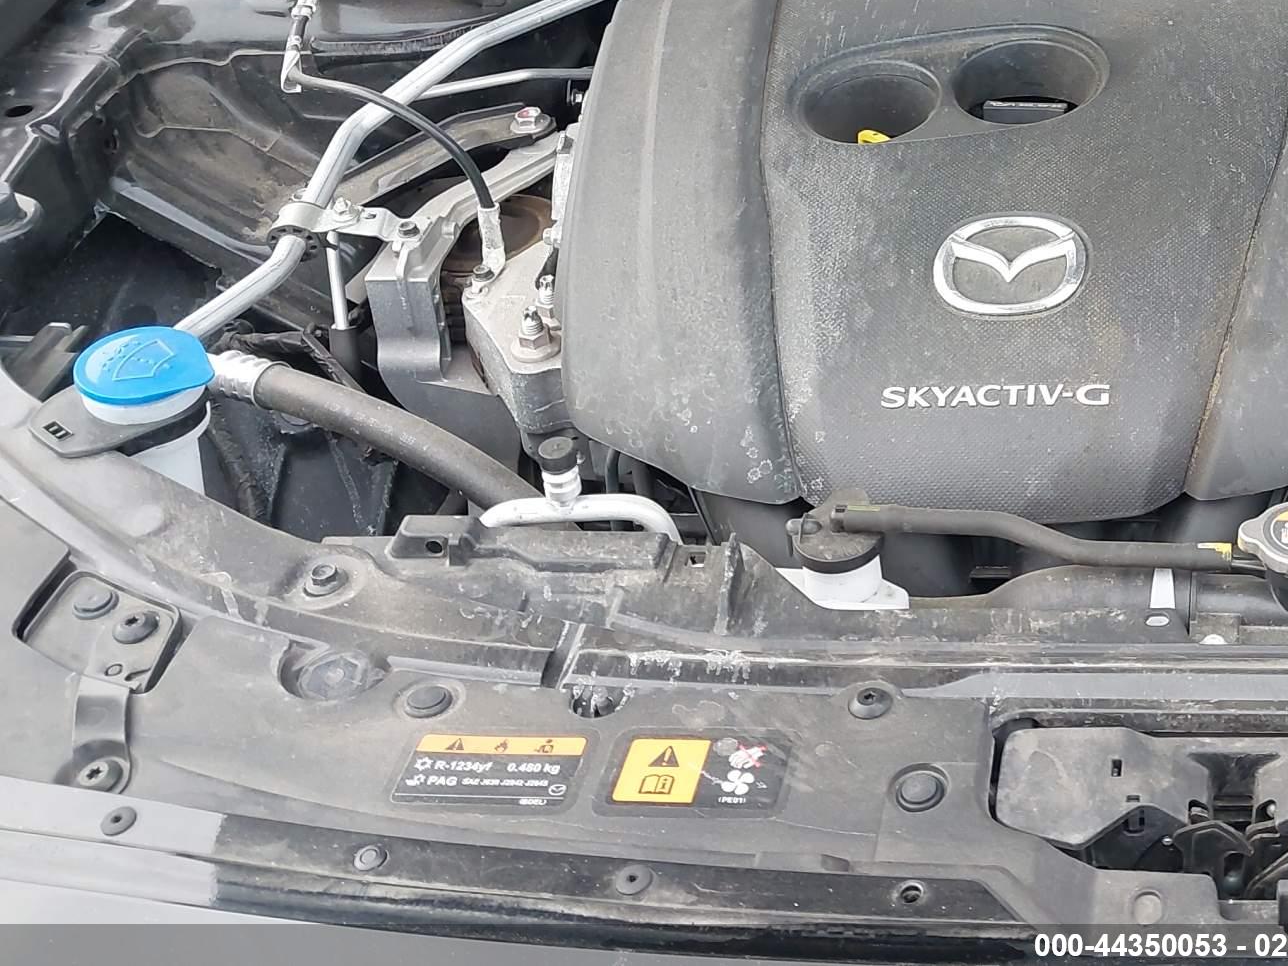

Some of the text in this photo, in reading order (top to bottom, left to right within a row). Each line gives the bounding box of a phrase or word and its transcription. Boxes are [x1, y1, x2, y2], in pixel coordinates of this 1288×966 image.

[880, 383, 1111, 409] SKYACTIV-G
[434, 760, 493, 774] R-1234yf
[543, 762, 561, 776] kg
[427, 775, 458, 786] PAG
